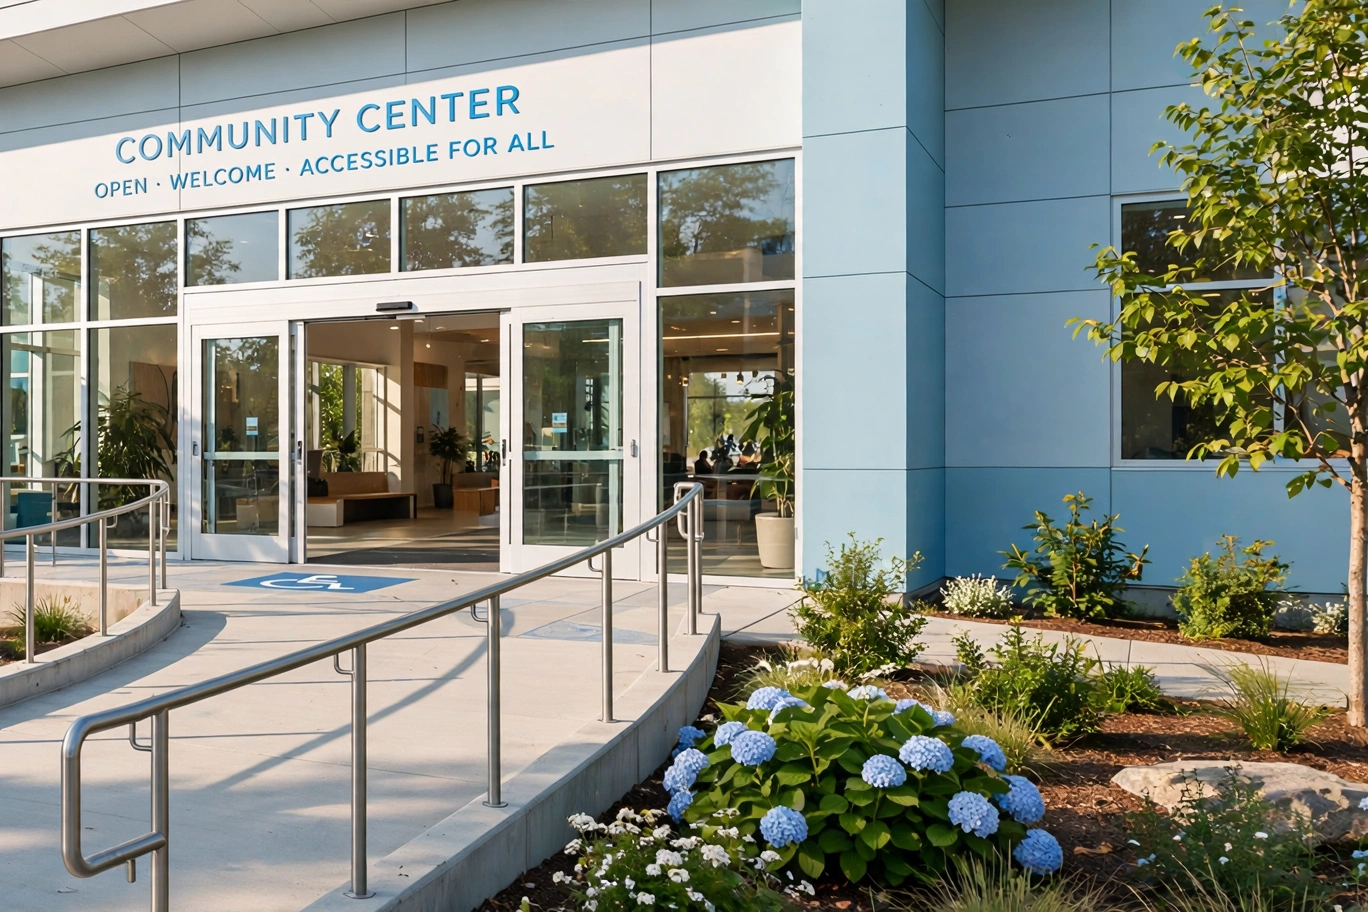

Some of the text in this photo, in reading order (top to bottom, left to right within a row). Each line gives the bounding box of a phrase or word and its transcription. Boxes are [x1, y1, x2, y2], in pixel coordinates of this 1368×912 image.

[115, 84, 521, 164] COMMUNITY CENTER
[94, 177, 148, 199] OPEN
[170, 163, 276, 190] WELCOME
[299, 143, 439, 176] ACCESSIBLE
[448, 137, 498, 160] FOR
[507, 130, 555, 153] ALL
